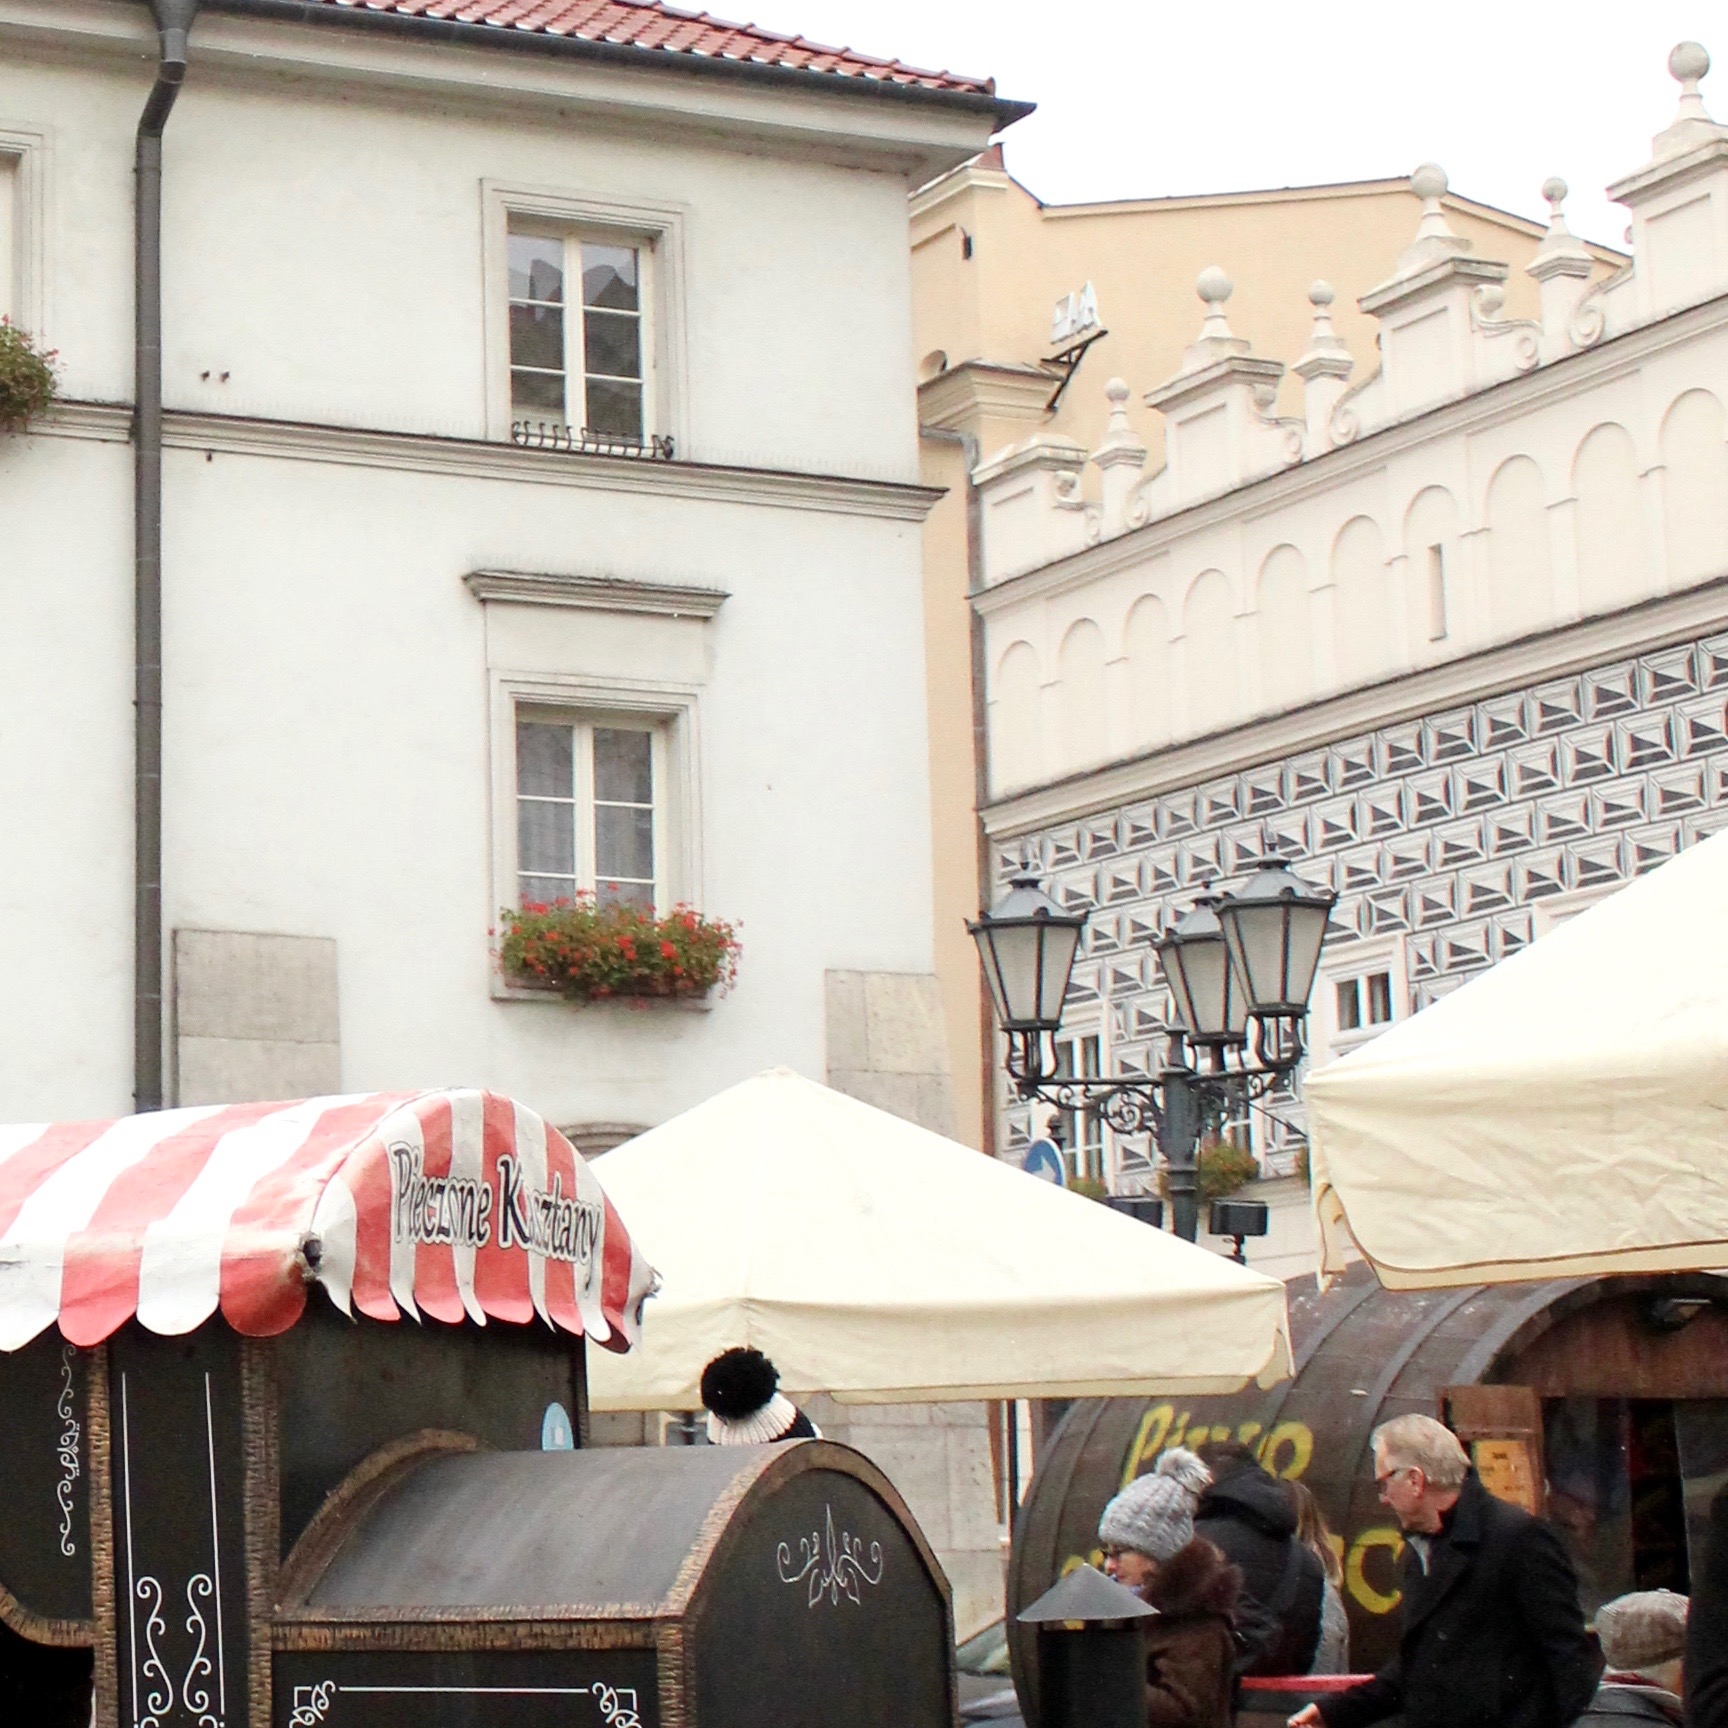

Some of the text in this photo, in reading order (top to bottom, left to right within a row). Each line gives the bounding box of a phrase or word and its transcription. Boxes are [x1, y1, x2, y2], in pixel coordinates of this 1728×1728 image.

[391, 1144, 603, 1291] Pieczone Ksztany
[1122, 1403, 1313, 1489] Pio
